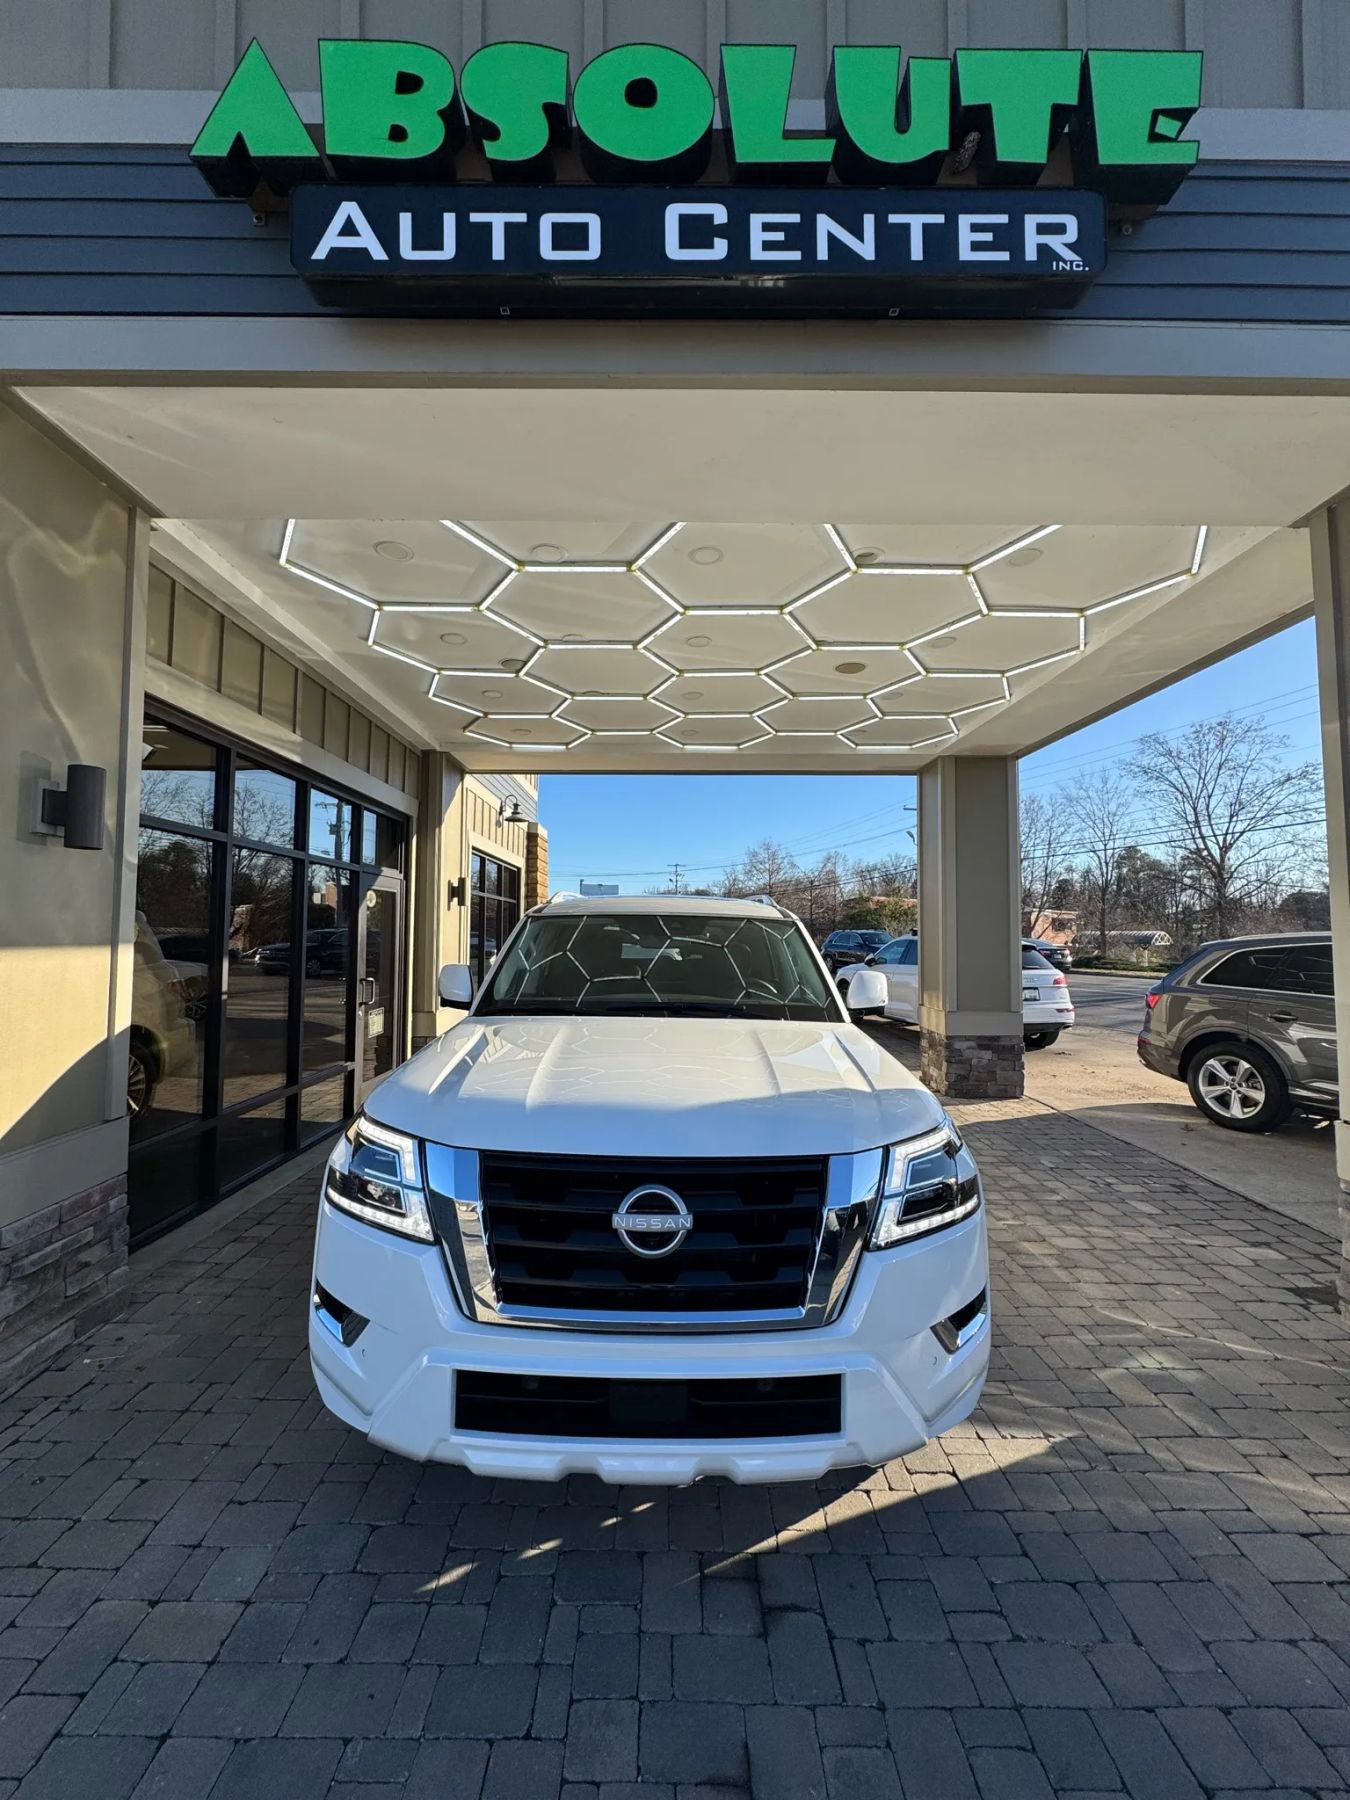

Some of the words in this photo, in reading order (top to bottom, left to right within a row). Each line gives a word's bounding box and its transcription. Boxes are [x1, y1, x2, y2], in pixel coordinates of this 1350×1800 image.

[191, 37, 1203, 166] ABSOLUTE
[310, 200, 602, 261] AUTO
[664, 202, 1083, 262] CENTER
[1052, 261, 1090, 271] INC.
[613, 1216, 691, 1229] NISSAN
